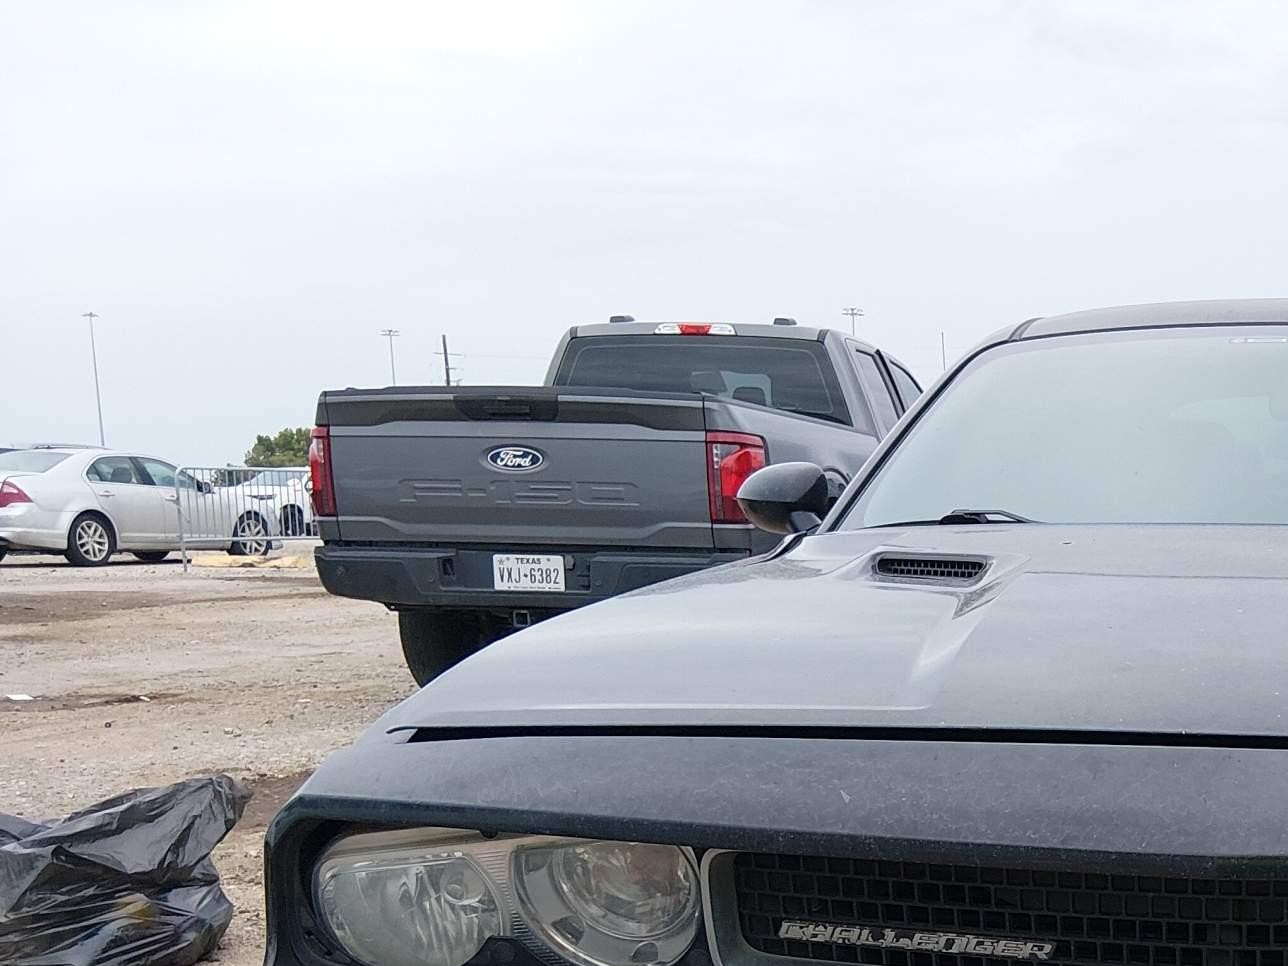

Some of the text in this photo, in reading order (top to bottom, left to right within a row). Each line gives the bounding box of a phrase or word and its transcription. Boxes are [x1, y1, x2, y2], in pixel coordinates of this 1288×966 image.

[496, 450, 533, 468] Ford
[398, 478, 641, 506] F-150
[514, 557, 542, 565] TEXAS
[778, 919, 1056, 961] CHALLENGER
